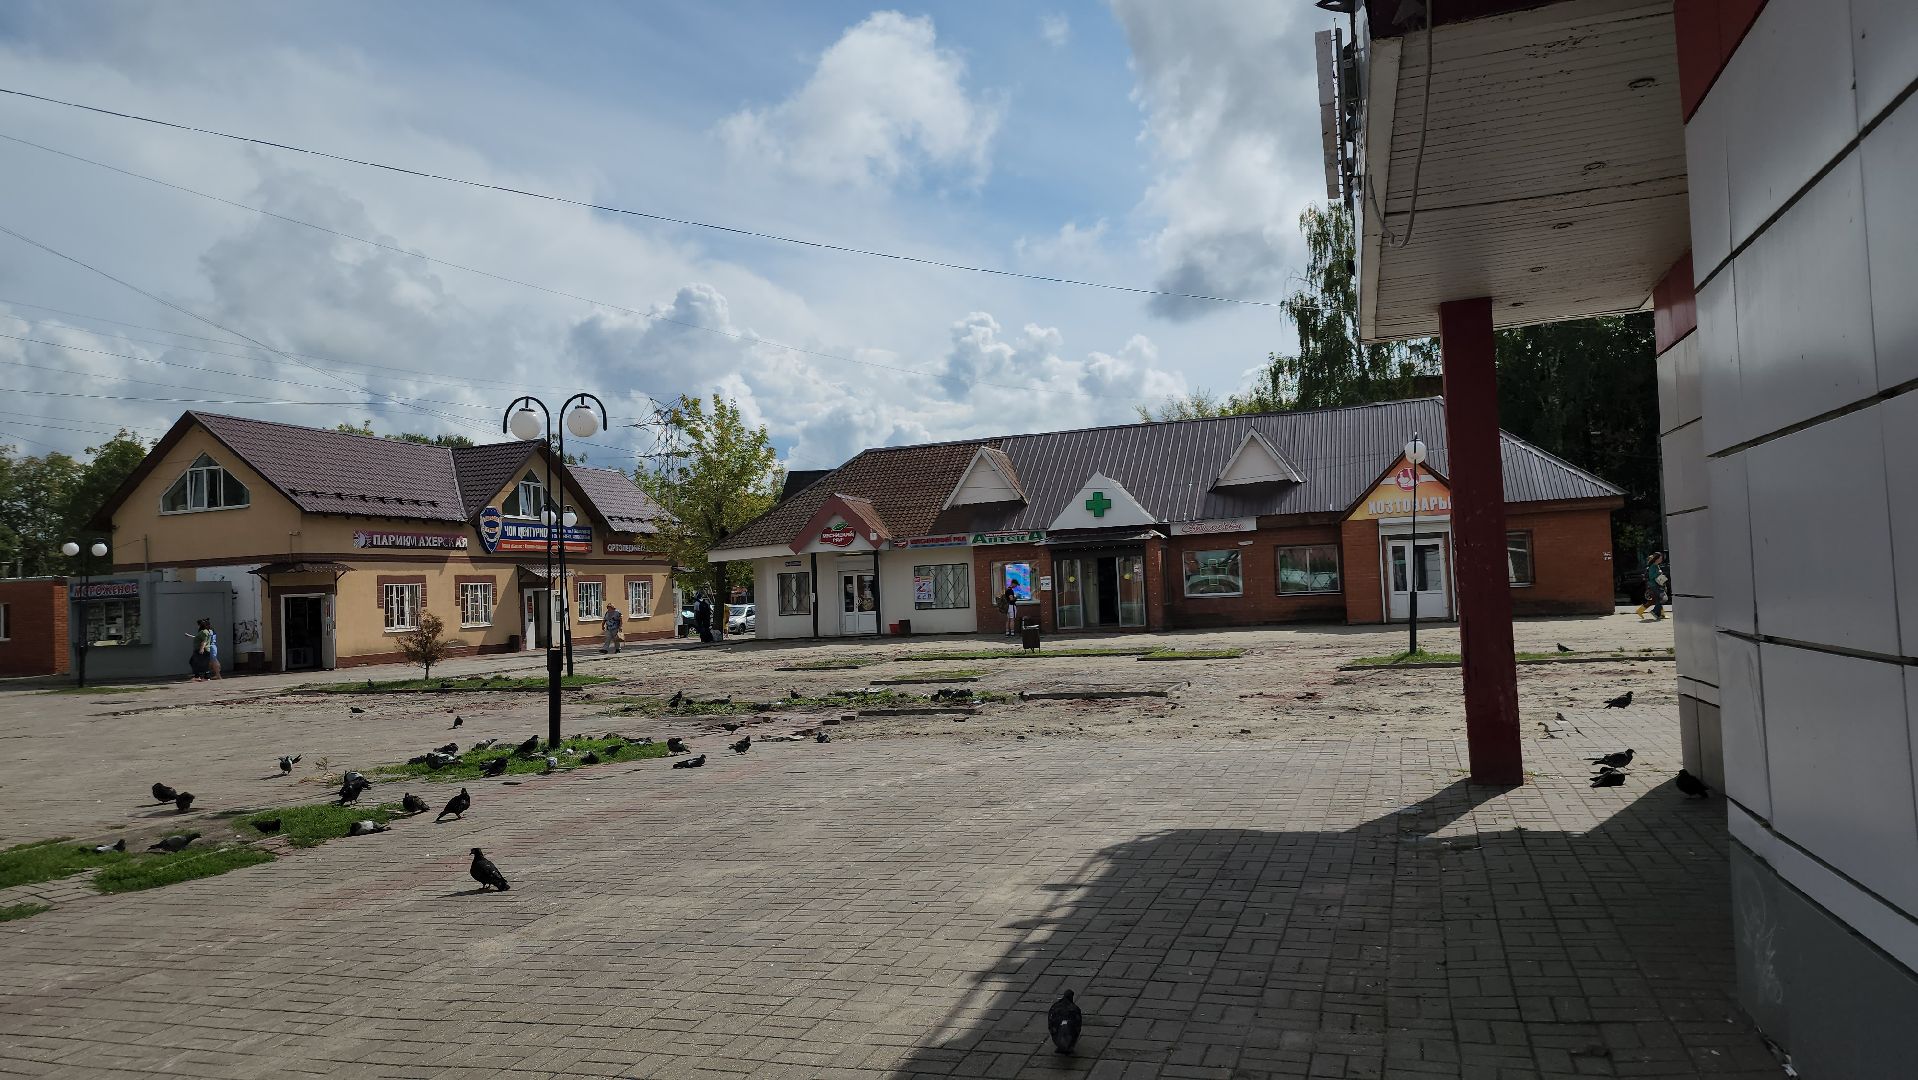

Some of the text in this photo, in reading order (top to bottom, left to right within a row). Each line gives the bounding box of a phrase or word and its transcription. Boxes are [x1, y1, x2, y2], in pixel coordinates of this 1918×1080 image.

[504, 526, 517, 538] ЧОП
[518, 526, 549, 539] ЦЕНТУРИО
[74, 583, 138, 598] МОРОЖЕНОЕ
